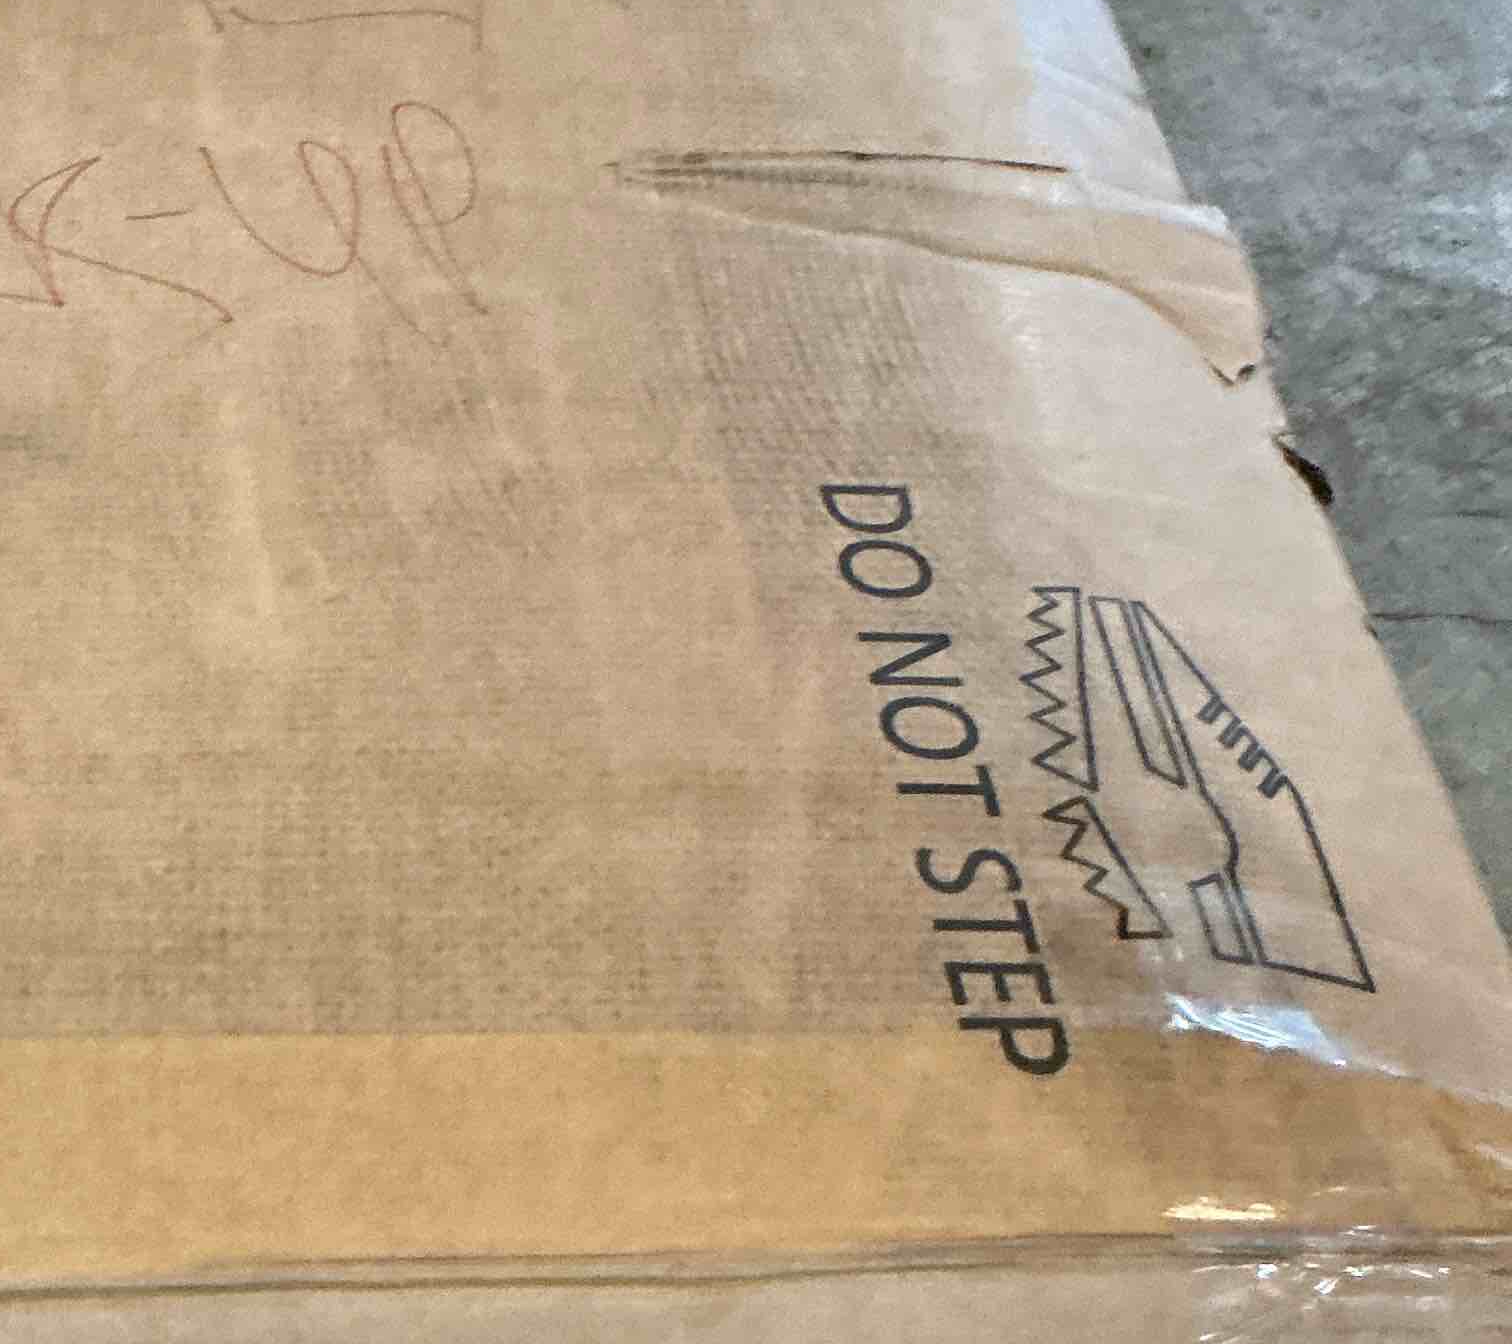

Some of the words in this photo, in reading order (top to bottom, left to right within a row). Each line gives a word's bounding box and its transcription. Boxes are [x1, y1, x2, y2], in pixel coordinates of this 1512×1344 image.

[819, 484, 932, 599] DO
[857, 631, 1000, 817] NOT
[915, 847, 1070, 1076] STEP
